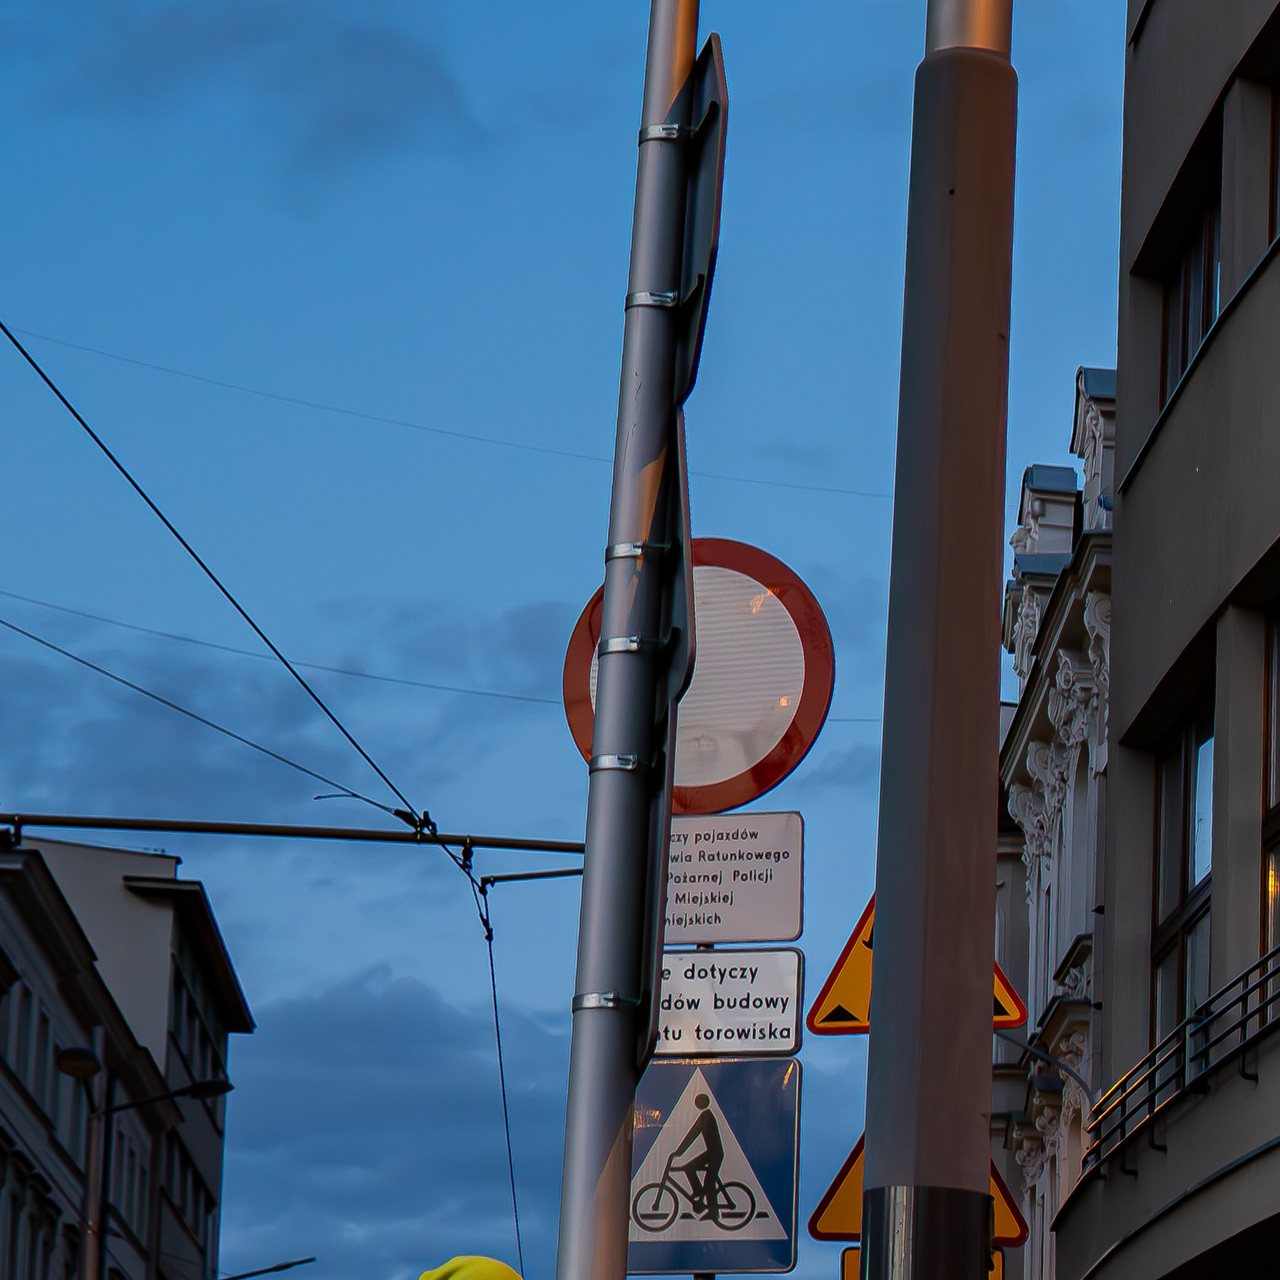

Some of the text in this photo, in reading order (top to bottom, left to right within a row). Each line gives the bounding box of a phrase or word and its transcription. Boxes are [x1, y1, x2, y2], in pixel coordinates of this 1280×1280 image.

[694, 828, 759, 845] pojazdów
[697, 849, 791, 864] Ratunkowego
[732, 867, 774, 883] Policji
[675, 890, 735, 907] Miejskiej
[683, 963, 759, 984] dotyczy
[661, 991, 790, 1014] dów budowy
[694, 1022, 791, 1041] torowiska
